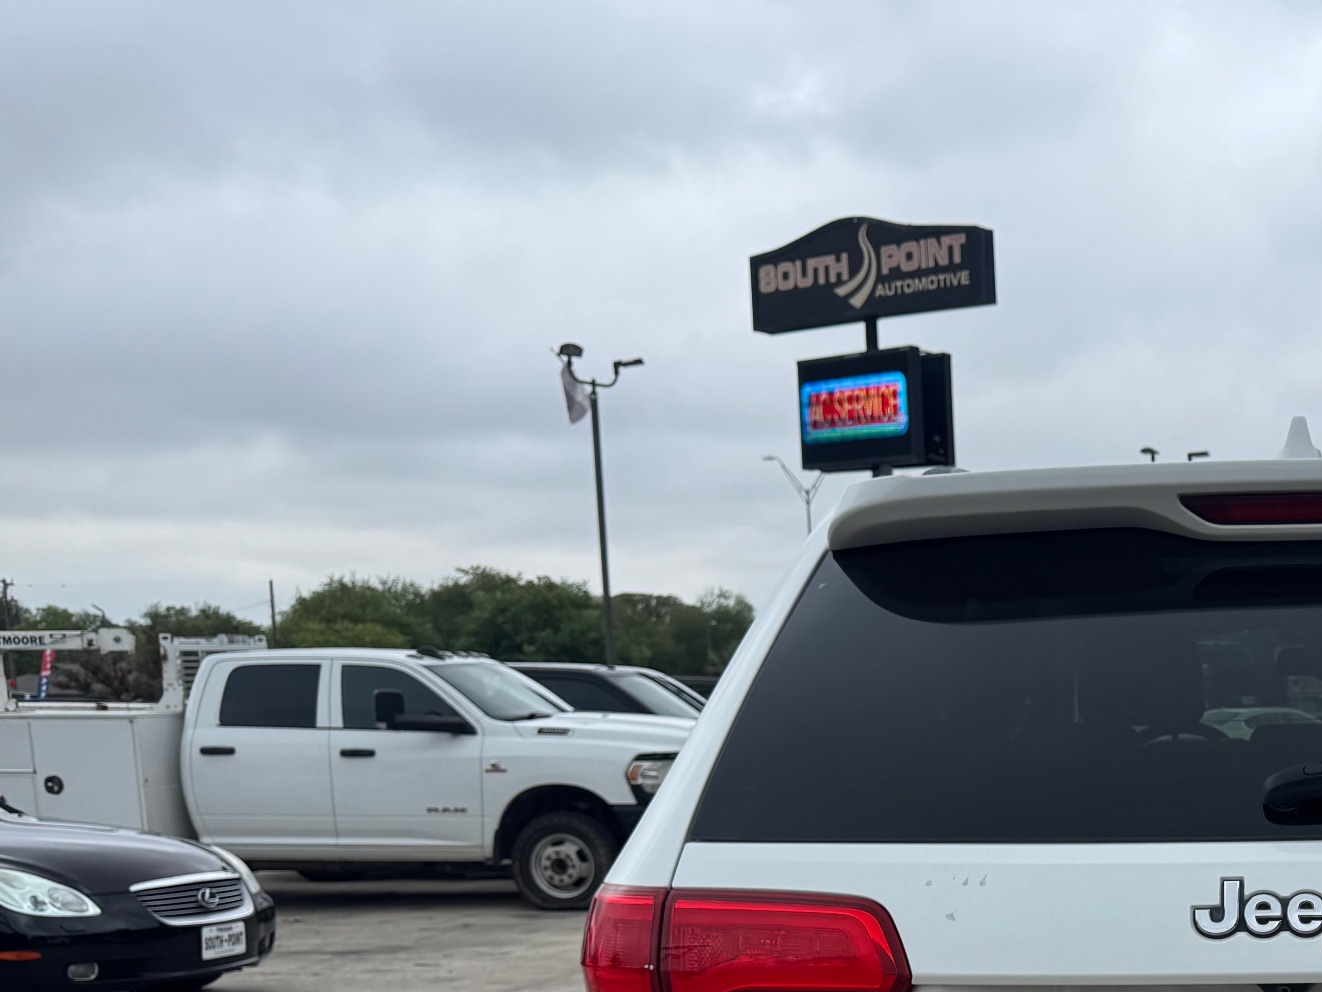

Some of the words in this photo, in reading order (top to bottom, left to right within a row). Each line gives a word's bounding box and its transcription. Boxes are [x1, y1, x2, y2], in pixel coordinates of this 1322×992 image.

[758, 252, 849, 293] SOUTH
[880, 233, 966, 275] POINT
[875, 269, 970, 298] AUTOMOTIVE
[0, 635, 46, 645] MOORE
